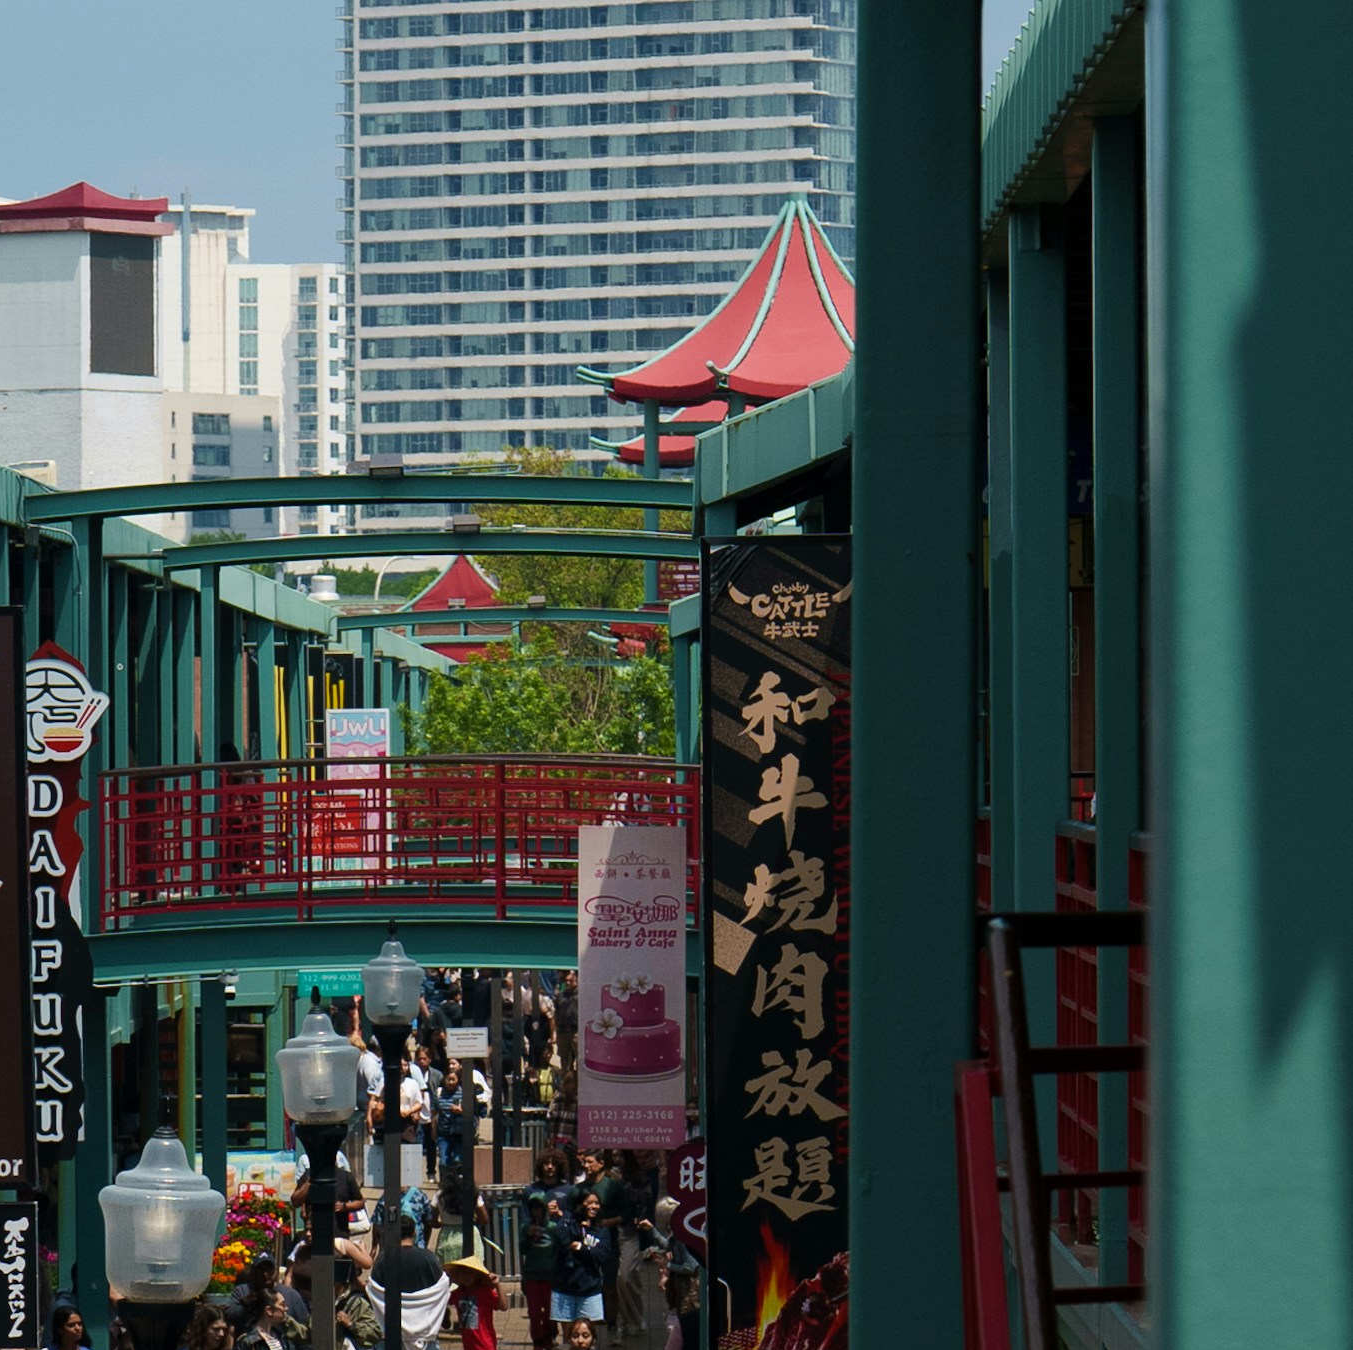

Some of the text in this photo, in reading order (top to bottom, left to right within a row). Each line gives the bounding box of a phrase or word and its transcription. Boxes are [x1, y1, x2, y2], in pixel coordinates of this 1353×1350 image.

[771, 581, 810, 594] Chubby
[751, 592, 832, 620] CATTLE
[763, 621, 820, 640] 牛武士
[587, 927, 678, 939] Saint Anna
[590, 937, 675, 949] Bakery & Cafe
[29, 775, 74, 1144] DAIFUKU
[588, 1110, 674, 1121] (312) 225-3168
[624, 1126, 654, 1134] Archer
[656, 1126, 674, 1134] Ave
[591, 1135, 632, 1144] Chicago,
[633, 1135, 642, 1143] IL
